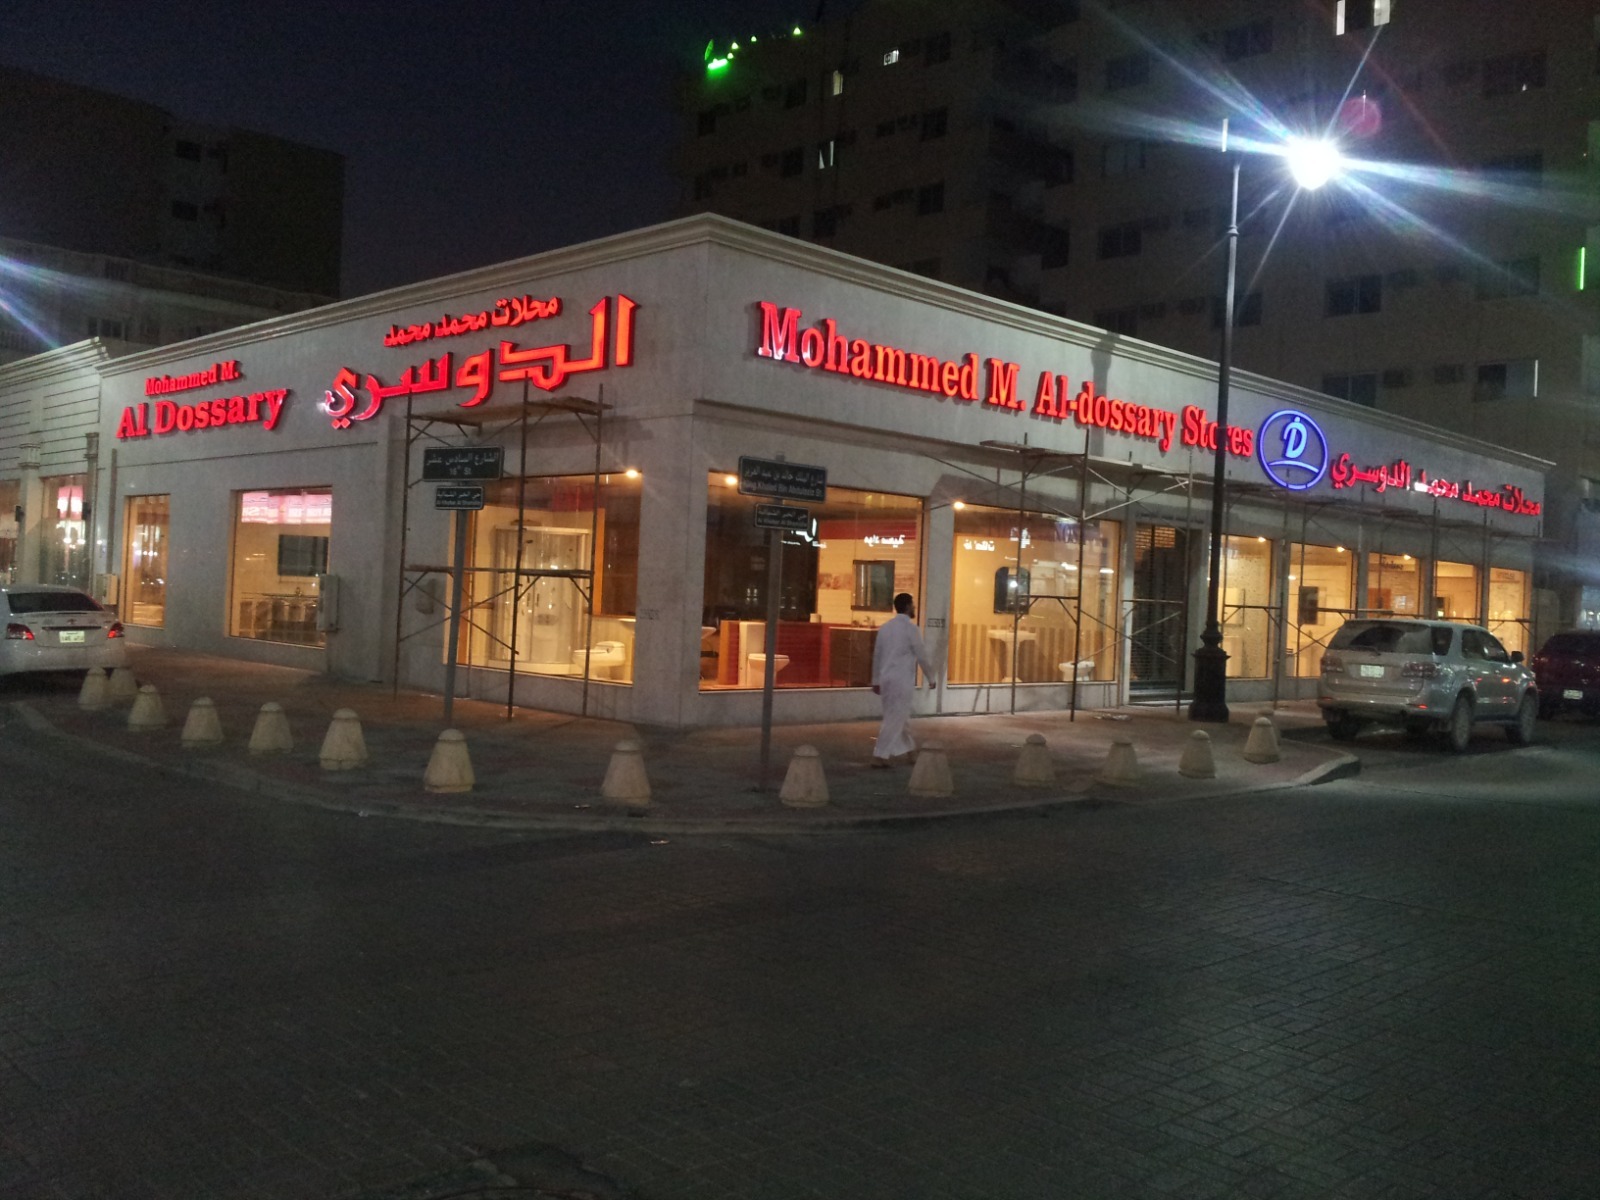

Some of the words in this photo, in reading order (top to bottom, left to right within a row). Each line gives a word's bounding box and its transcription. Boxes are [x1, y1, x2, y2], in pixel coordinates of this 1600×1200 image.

[434, 310, 486, 338] محمد
[491, 294, 561, 327] محلات
[383, 324, 430, 347] محمد
[144, 364, 217, 396] Mohammed
[220, 360, 240, 381] M.
[323, 293, 636, 430] الدوسري
[757, 301, 979, 400] Mohammed
[988, 357, 1027, 411] M.
[1036, 371, 1178, 452] Al-dossary
[116, 402, 149, 439] Al
[153, 388, 290, 434] Dossary
[1332, 452, 1411, 493] الدوسري
[1413, 469, 1459, 498] محمد
[1463, 480, 1500, 507] محمد
[1502, 483, 1541, 516] محلات
